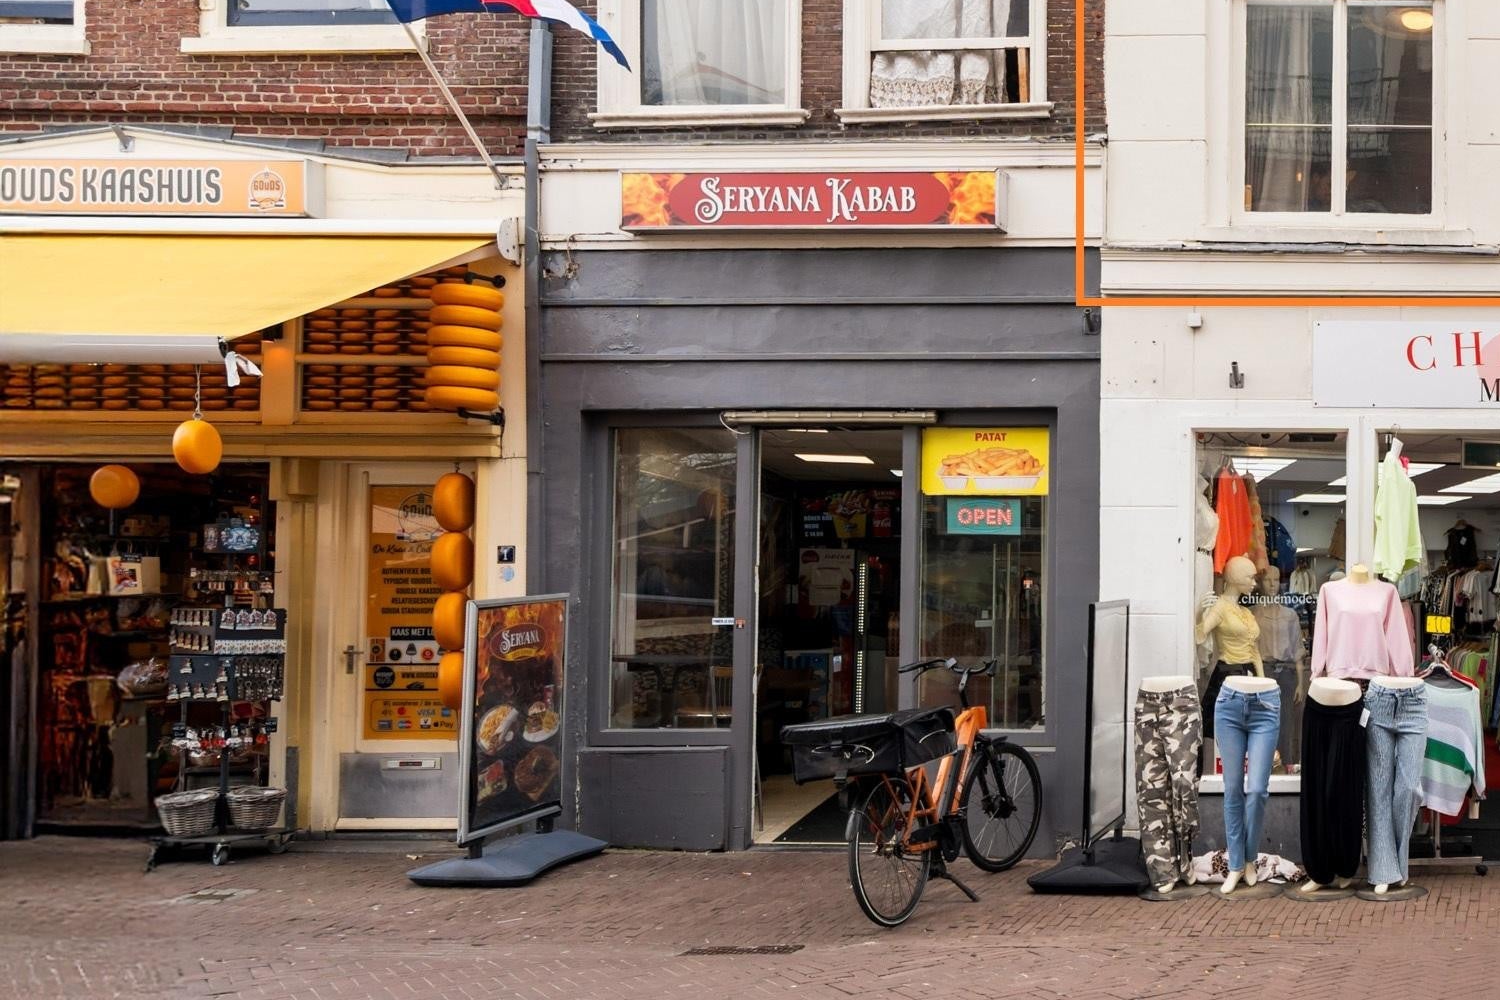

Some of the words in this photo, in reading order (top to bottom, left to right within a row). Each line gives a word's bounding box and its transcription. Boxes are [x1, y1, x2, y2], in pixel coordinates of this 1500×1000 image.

[82, 168, 222, 204] KAASHUIS
[694, 177, 821, 223] SERYANA
[826, 178, 916, 223] KABAB
[975, 432, 1007, 442] PATAT
[957, 508, 1012, 526] OPEN
[1239, 592, 1319, 607] .chiquemode.
[391, 628, 410, 636] KAAS
